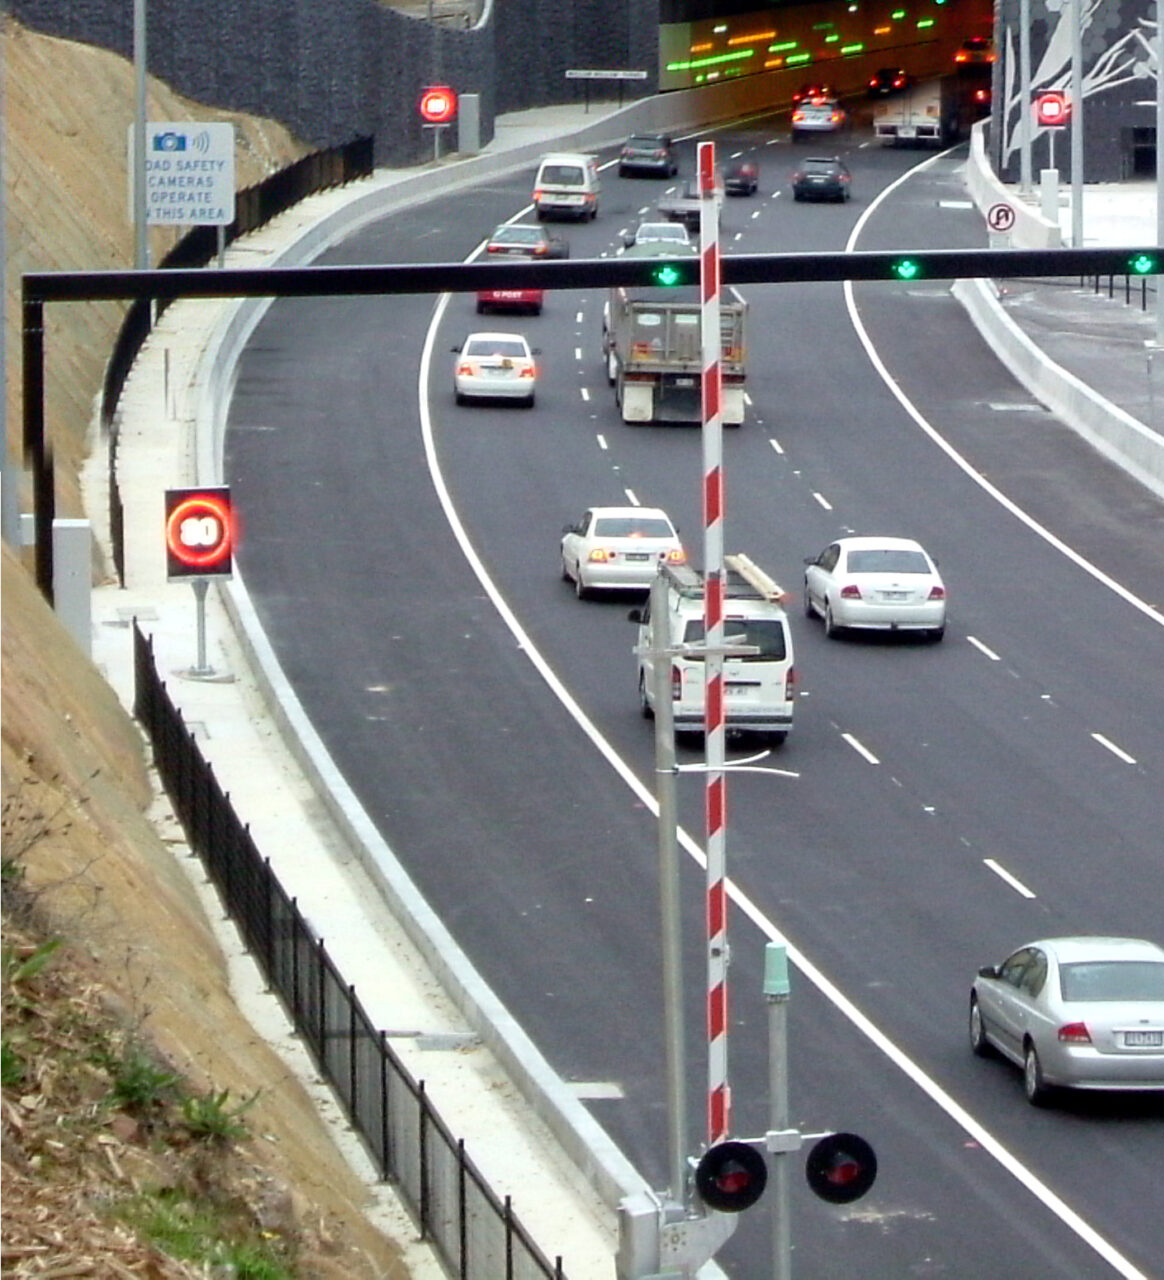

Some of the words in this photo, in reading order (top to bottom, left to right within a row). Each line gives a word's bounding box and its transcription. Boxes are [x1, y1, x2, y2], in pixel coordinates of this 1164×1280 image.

[144, 160, 172, 172] OAD
[176, 160, 225, 172] SAFETY
[148, 176, 214, 188] CAMERAS
[151, 192, 212, 204] OPERATE
[156, 208, 185, 219] THIS
[190, 208, 225, 219] AREA
